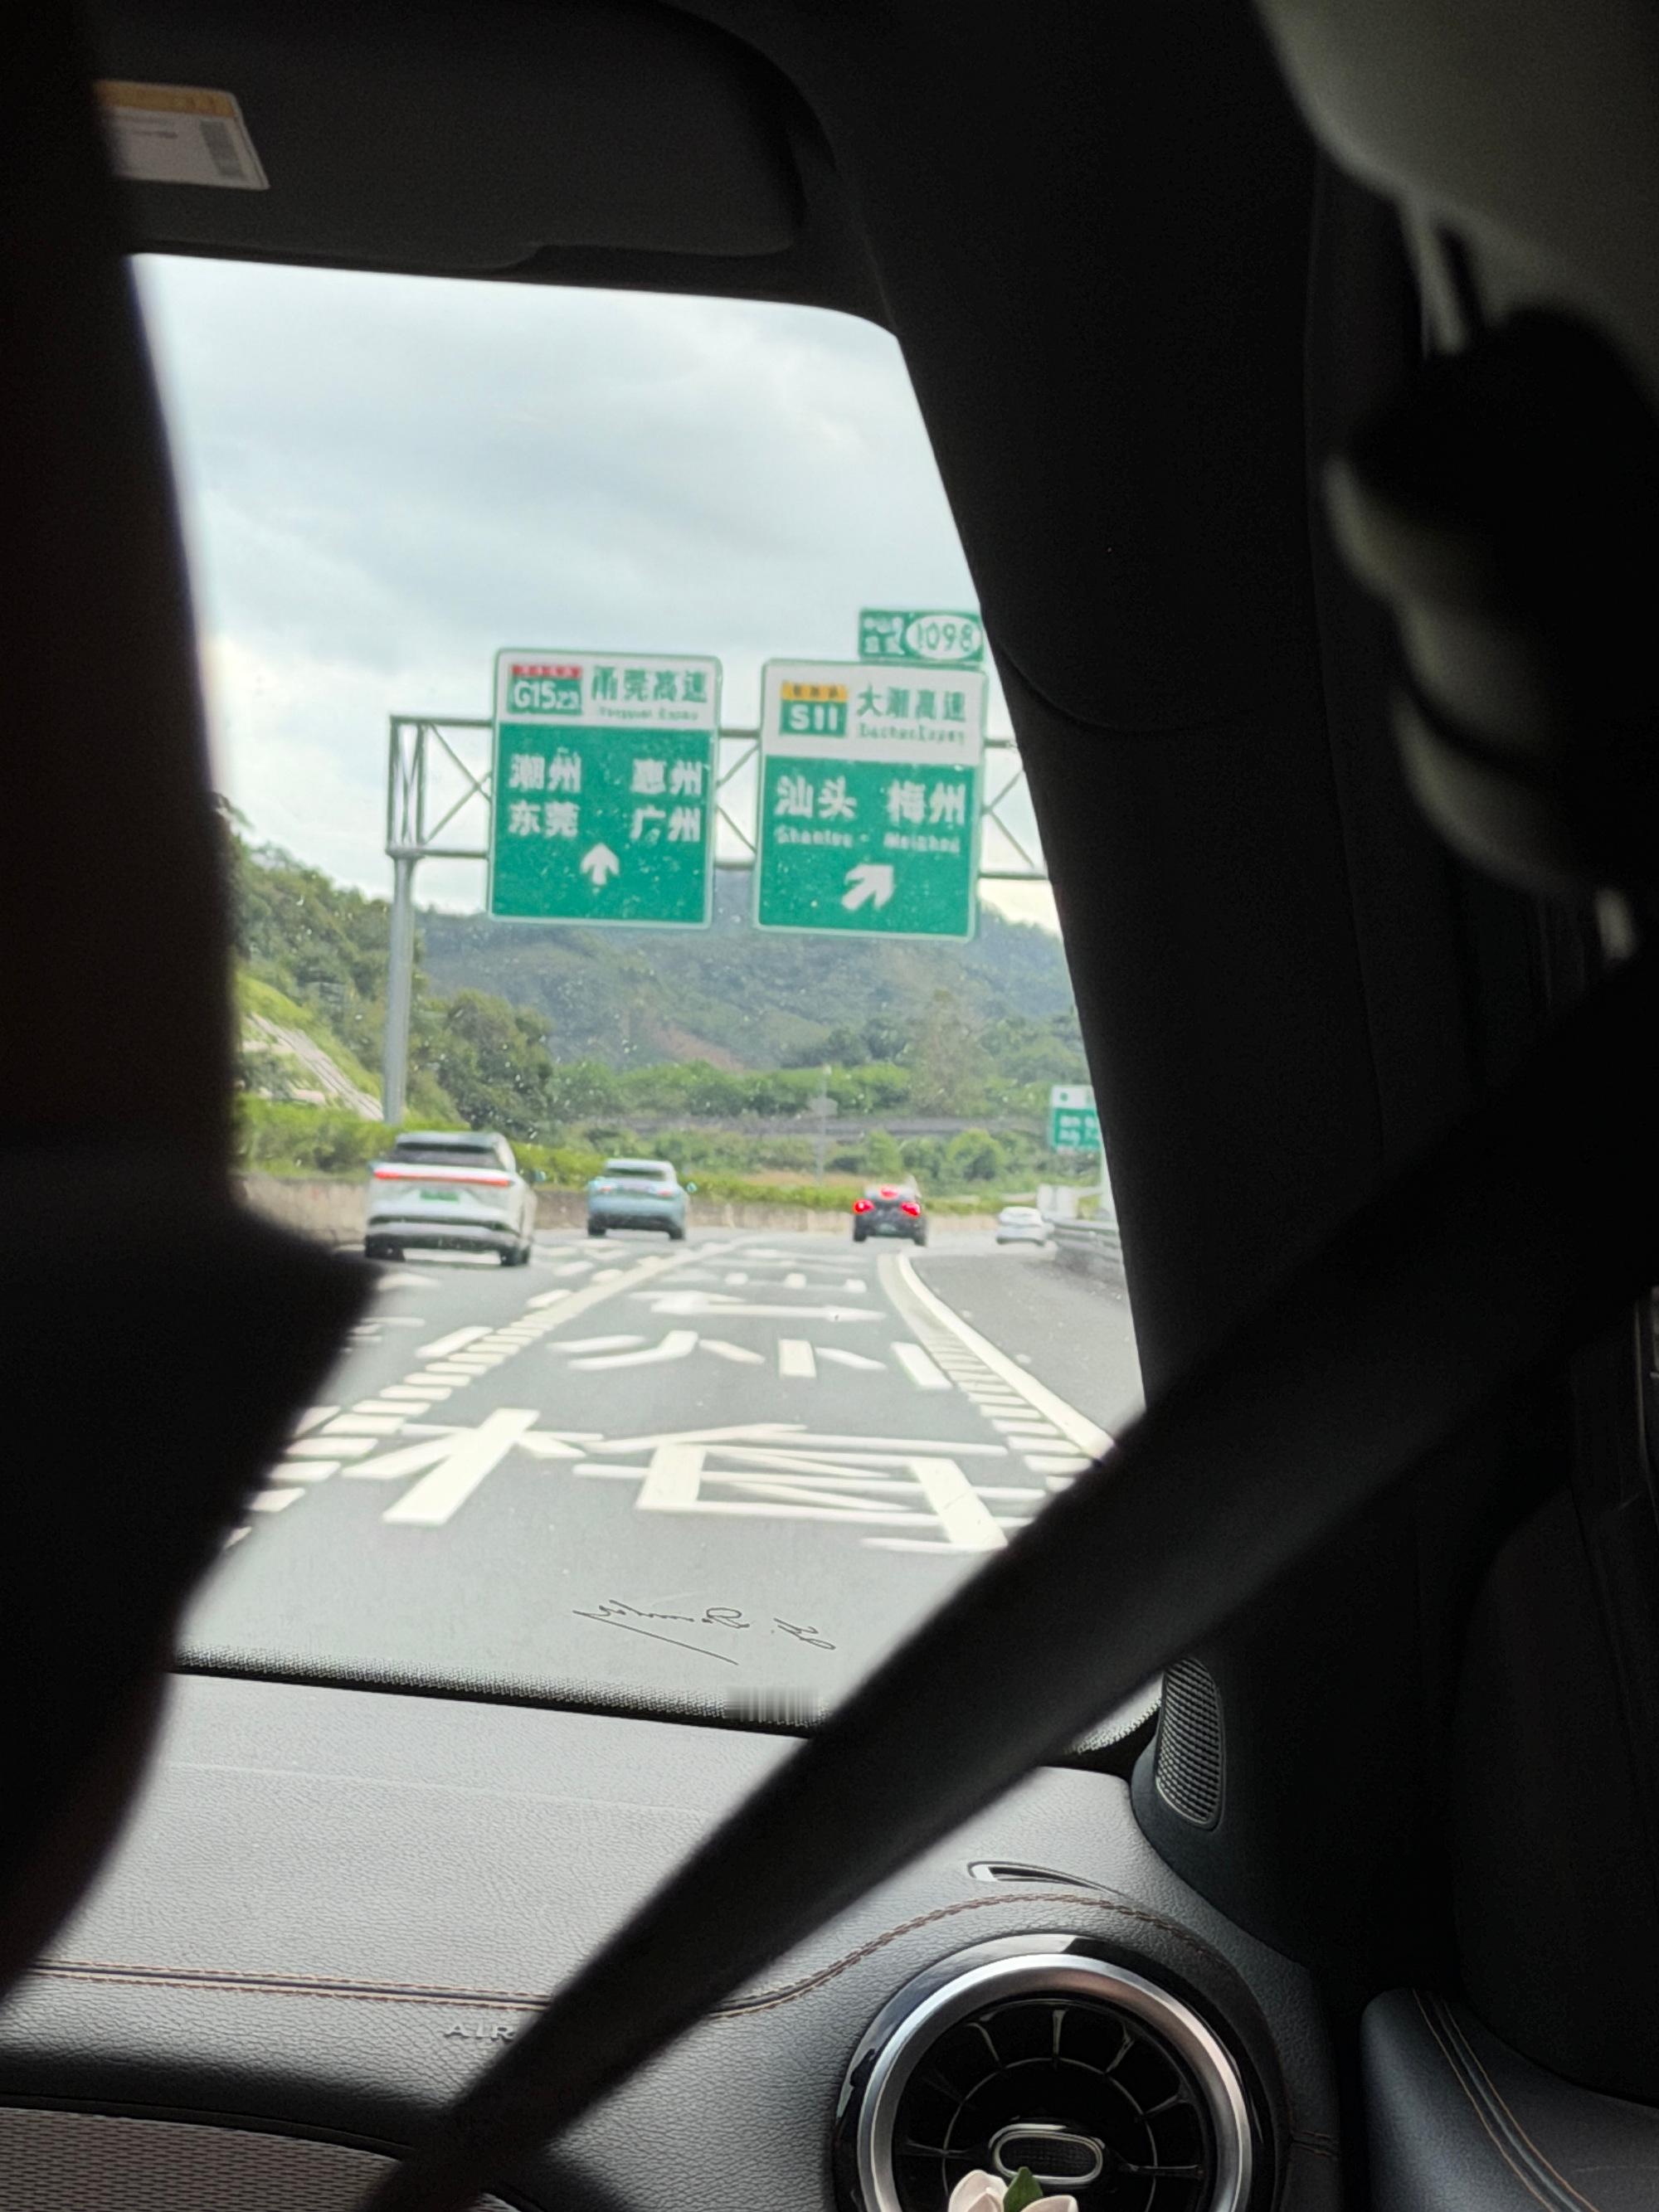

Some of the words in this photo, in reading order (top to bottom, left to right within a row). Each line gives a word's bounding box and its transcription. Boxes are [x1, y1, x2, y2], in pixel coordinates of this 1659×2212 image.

[917, 623, 972, 652] 1098
[790, 704, 839, 732] S11
[775, 775, 857, 819] 汕头
[886, 779, 966, 824] 梅州
[508, 799, 580, 839] 东莞
[629, 805, 701, 843] 广州
